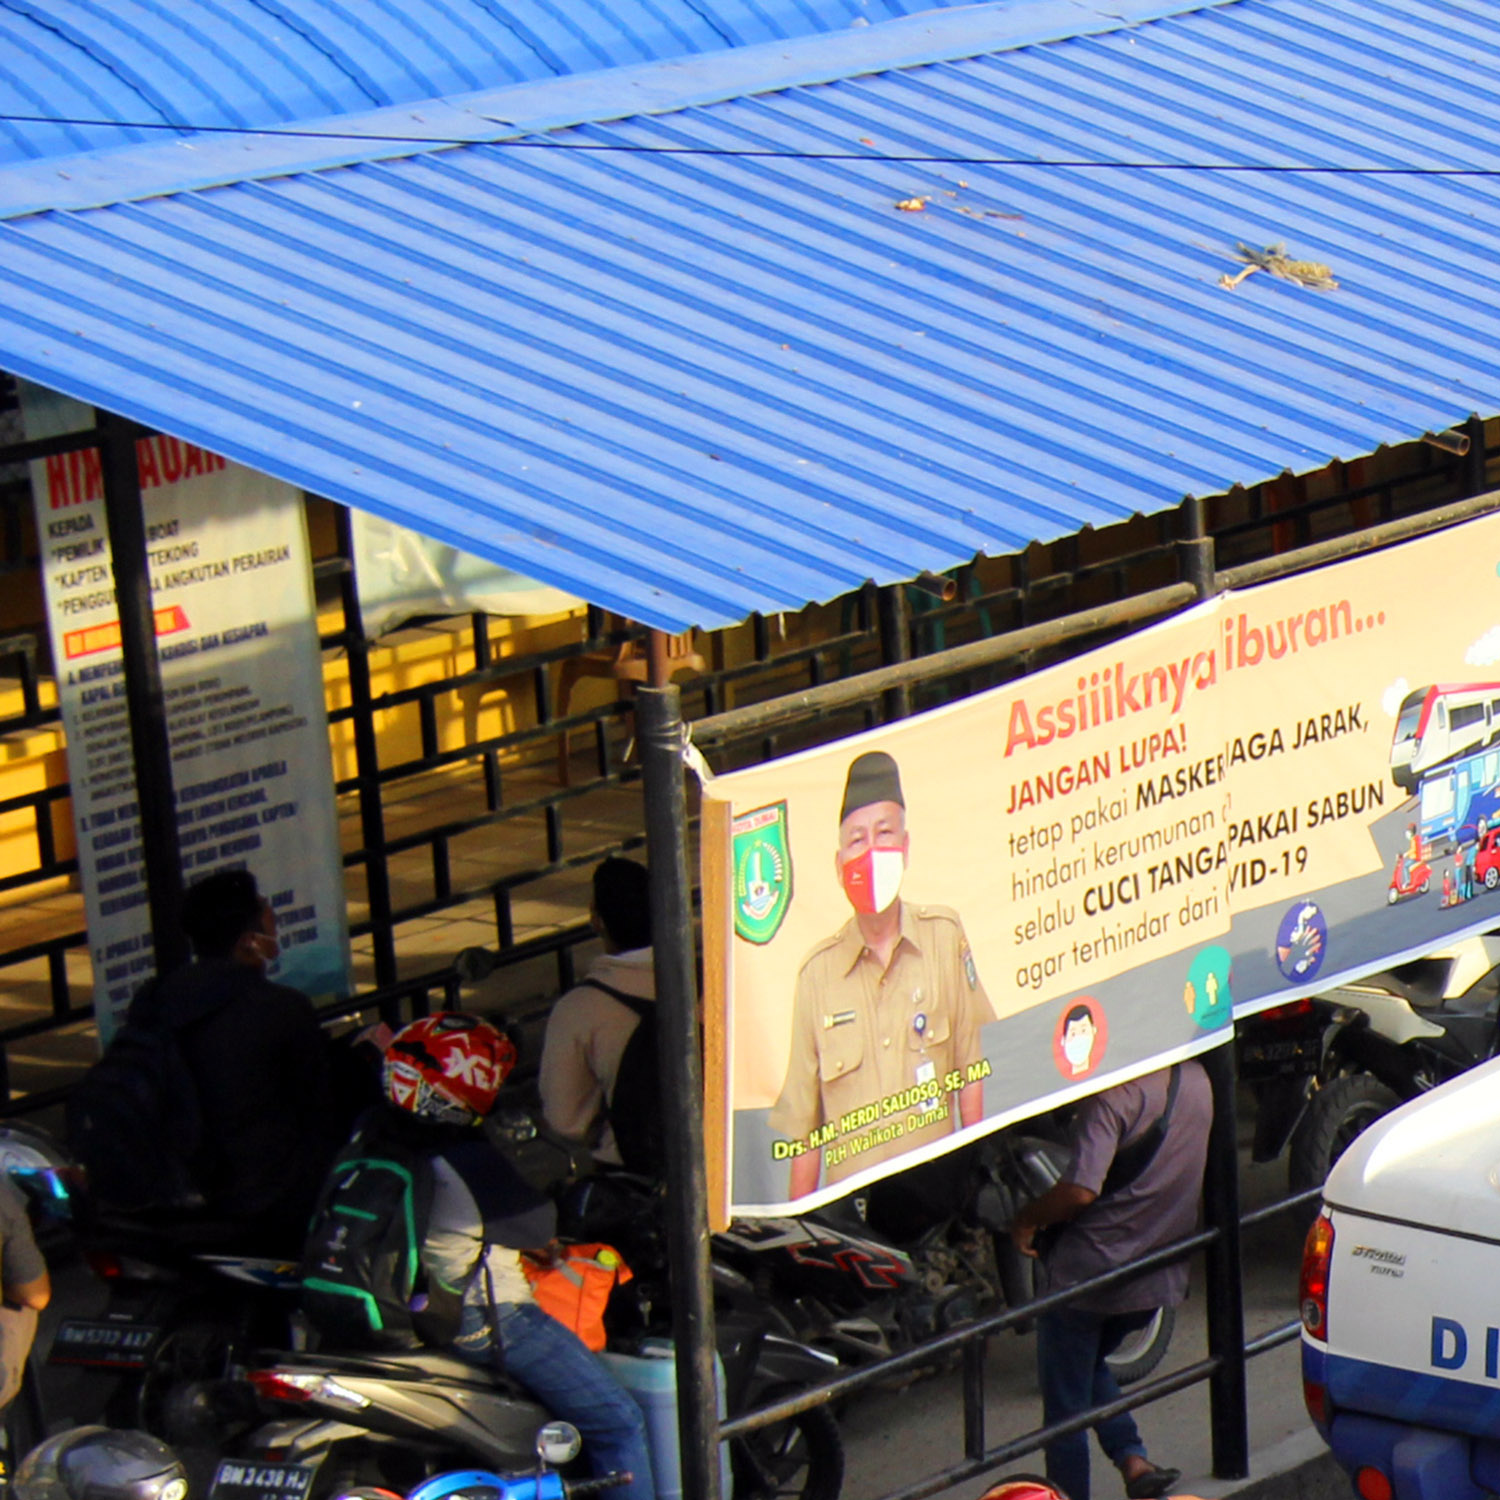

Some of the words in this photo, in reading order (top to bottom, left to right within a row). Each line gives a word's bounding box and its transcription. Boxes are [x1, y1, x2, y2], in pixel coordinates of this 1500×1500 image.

[45, 432, 227, 510] HIMAUAN
[48, 513, 95, 539] KEPADA
[164, 562, 229, 591] ANGKUTAN
[232, 545, 292, 574] PERAIRAN
[1003, 645, 1217, 758] Assiiiknya
[1225, 599, 1386, 671] iburan...
[1006, 751, 1112, 814] JANGAN
[1119, 722, 1188, 774] LUPA!
[1008, 820, 1063, 858] tetap
[1071, 788, 1128, 840] pakai
[1226, 727, 1285, 767] AGA
[1291, 702, 1370, 752] JARAK,
[1011, 846, 1087, 901] hindari
[1094, 809, 1216, 873] kerumunan
[1014, 900, 1076, 945] selalu
[1083, 871, 1141, 917] CUCI
[1147, 840, 1228, 892] TANGA
[1229, 806, 1299, 852] PAKAI
[1306, 779, 1385, 828] SABUN
[1016, 953, 1066, 991] agar
[1072, 903, 1171, 969] terhindar
[1179, 890, 1219, 927] dari
[1226, 845, 1309, 905] VID-19
[772, 1135, 808, 1162] Drs.
[809, 1118, 839, 1150] H.M.
[840, 1101, 880, 1133] HERDI
[882, 1081, 943, 1122] SALIOSO,
[944, 1067, 965, 1095] SE,
[967, 1058, 992, 1082] MA
[824, 1143, 848, 1168] PLH
[849, 1118, 905, 1156] Walikota
[907, 1101, 949, 1132] Dumai
[220, 1464, 244, 1485] BM
